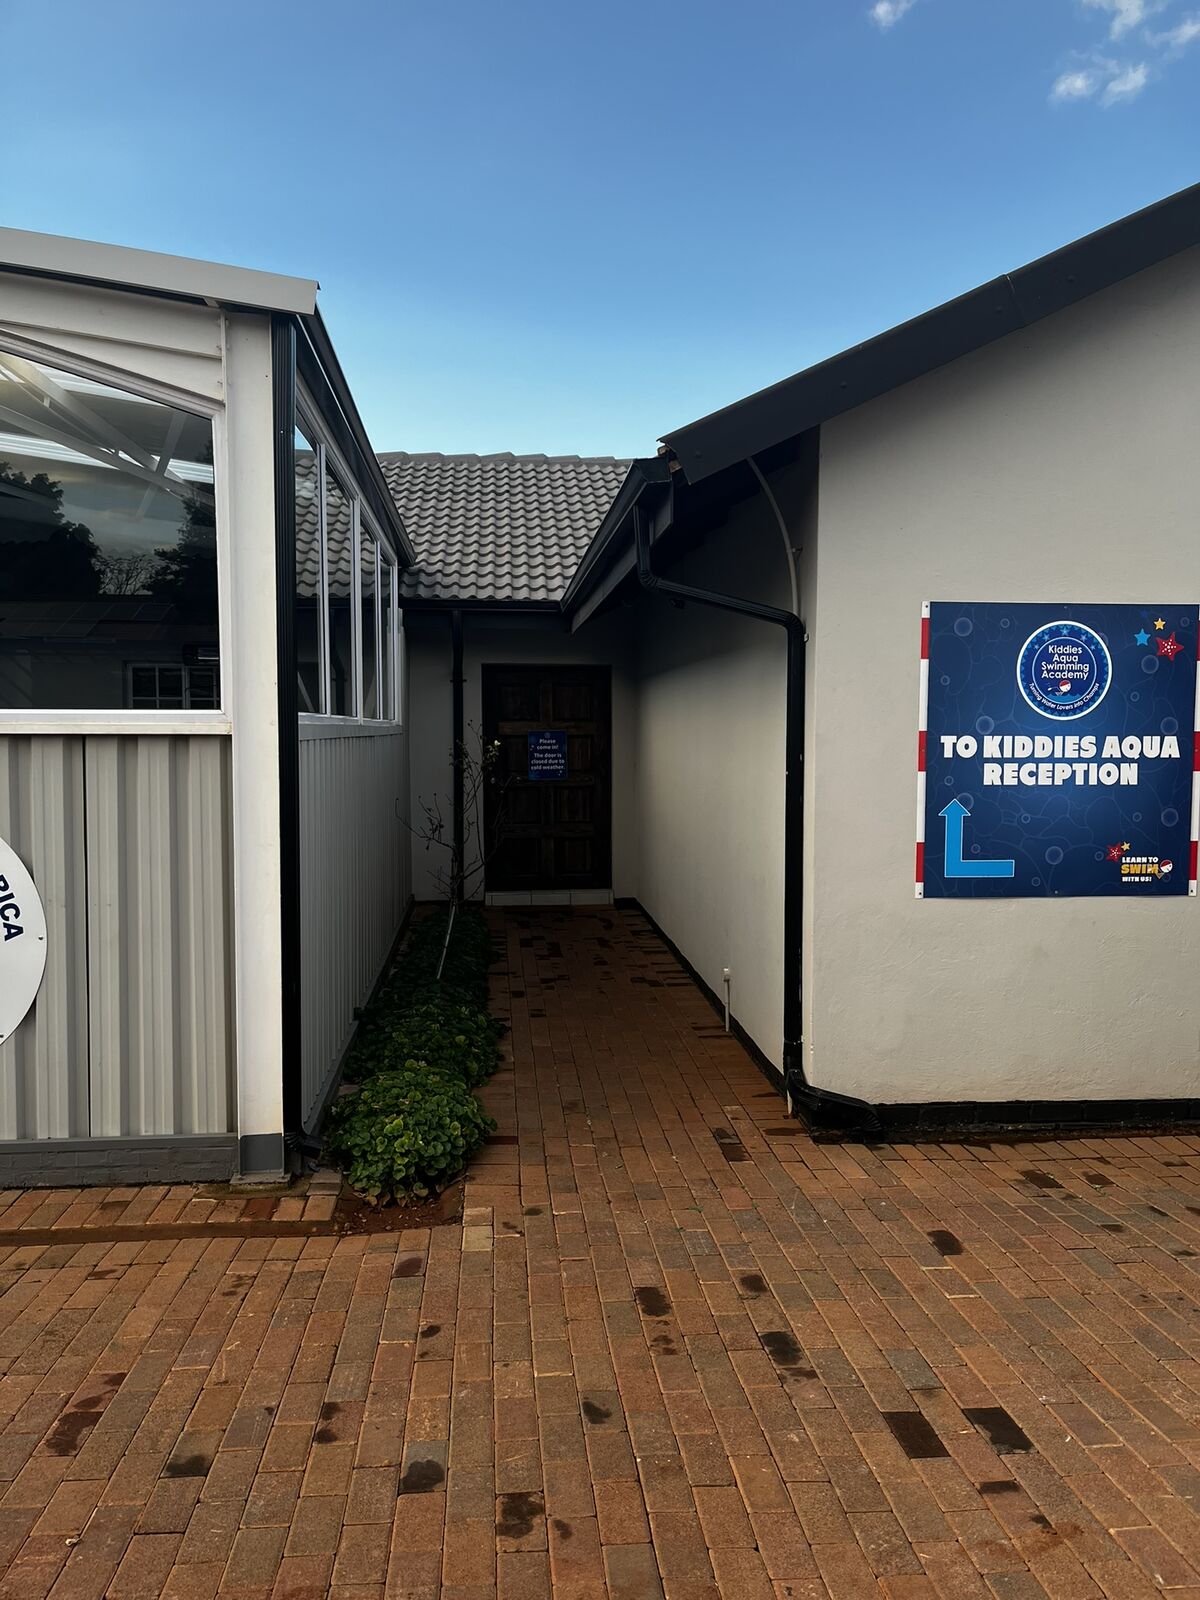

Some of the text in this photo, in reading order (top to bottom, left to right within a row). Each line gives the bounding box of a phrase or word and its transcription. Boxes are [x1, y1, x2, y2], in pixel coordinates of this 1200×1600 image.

[1048, 645, 1082, 654] Kiddies
[1052, 653, 1079, 663] Aqua
[1041, 661, 1089, 672] Swimming
[1041, 670, 1089, 680] Academy
[1041, 697, 1056, 709] Water
[1073, 700, 1084, 709] into
[1083, 682, 1100, 702] Champs
[940, 735, 1180, 760] TO KIDDIES AQUA
[983, 763, 1138, 786] RECEPTION
[1121, 863, 1159, 874] SWIM
